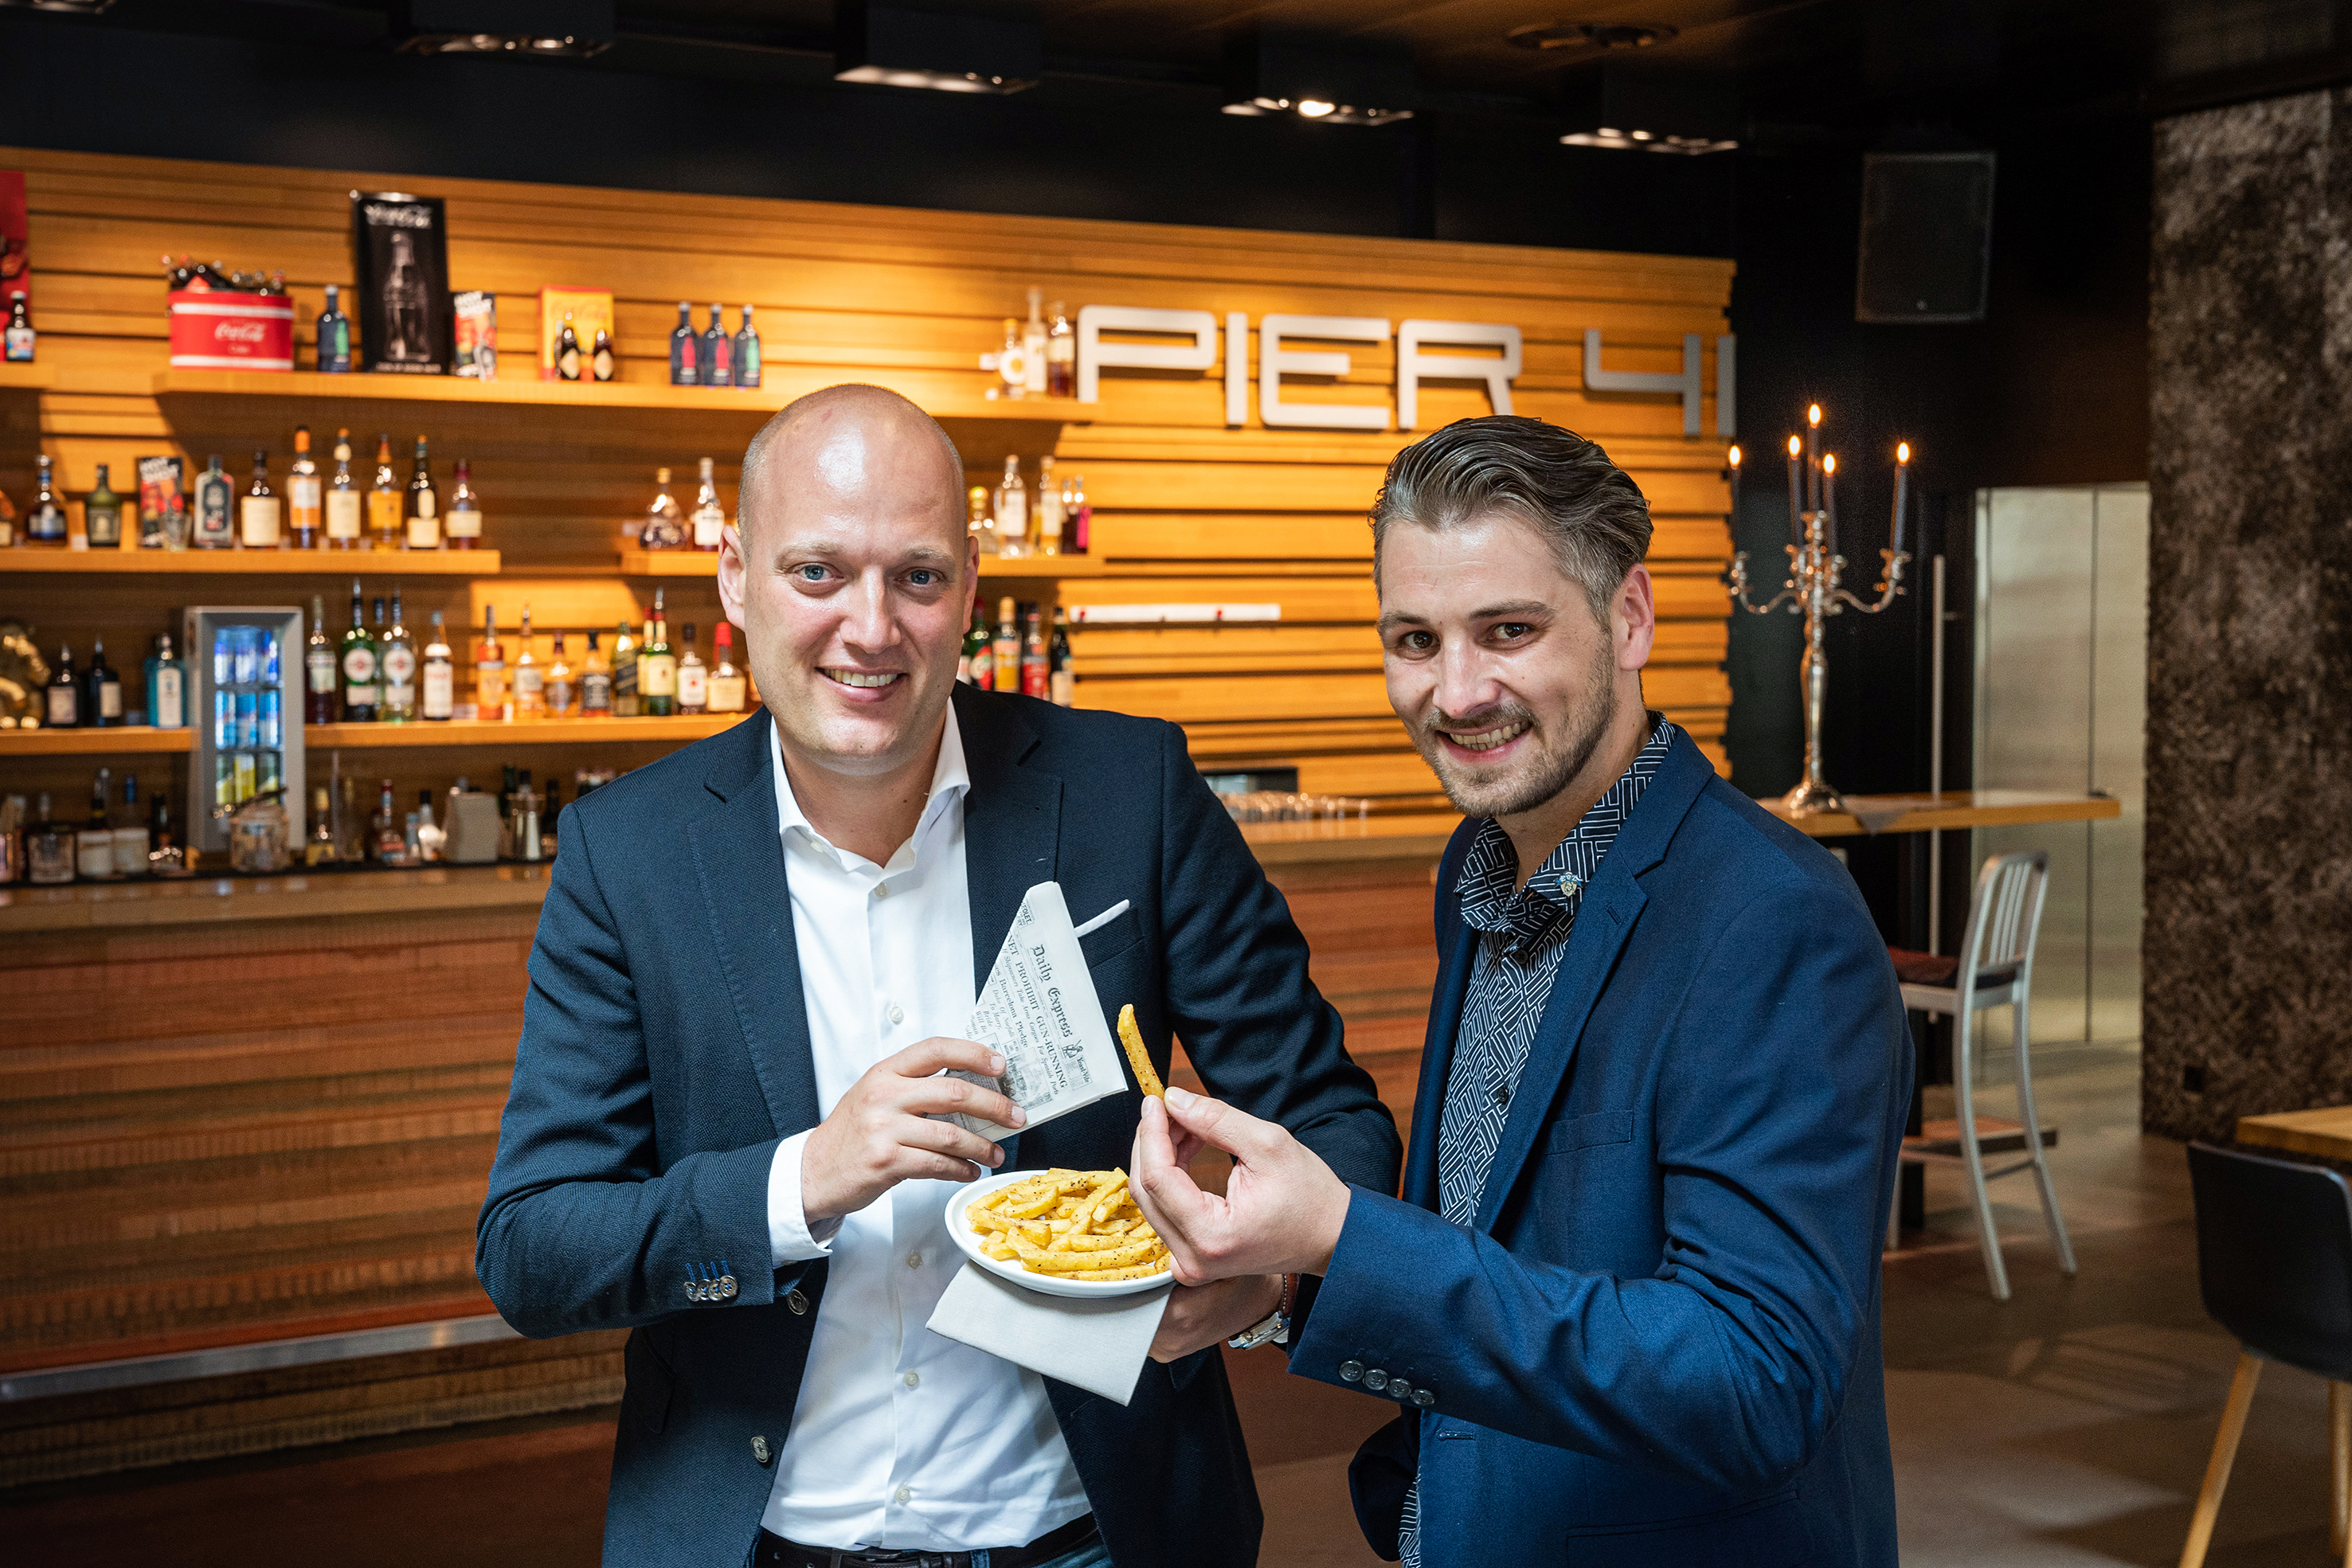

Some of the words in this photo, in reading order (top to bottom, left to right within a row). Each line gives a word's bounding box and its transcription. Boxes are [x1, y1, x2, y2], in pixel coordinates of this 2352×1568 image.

[1077, 303, 1523, 432] PIER
[975, 1011, 984, 1023] Will
[980, 1025, 987, 1034] Be
[982, 1011, 993, 1027] Bride
[989, 1002, 996, 1011] To
[992, 989, 1001, 1004] Duke
[1002, 1017, 1016, 1038] Norfolk
[999, 979, 1017, 1019] Barcelona
[1015, 1021, 1027, 1047] Pledge
[1016, 962, 1039, 1010] PROHIBIT
[1036, 1015, 1067, 1088] GUN-RUNNING
[1031, 944, 1052, 982] Daily
[1047, 987, 1073, 1038] Express
[1004, 956, 1019, 987] Shipowners
[1016, 988, 1025, 1003] Take
[1022, 1005, 1031, 1019] Arms
[1028, 1022, 1039, 1043] Cargoes
[1040, 1057, 1054, 1079] Spanish
[1050, 1081, 1059, 1095] Ports
